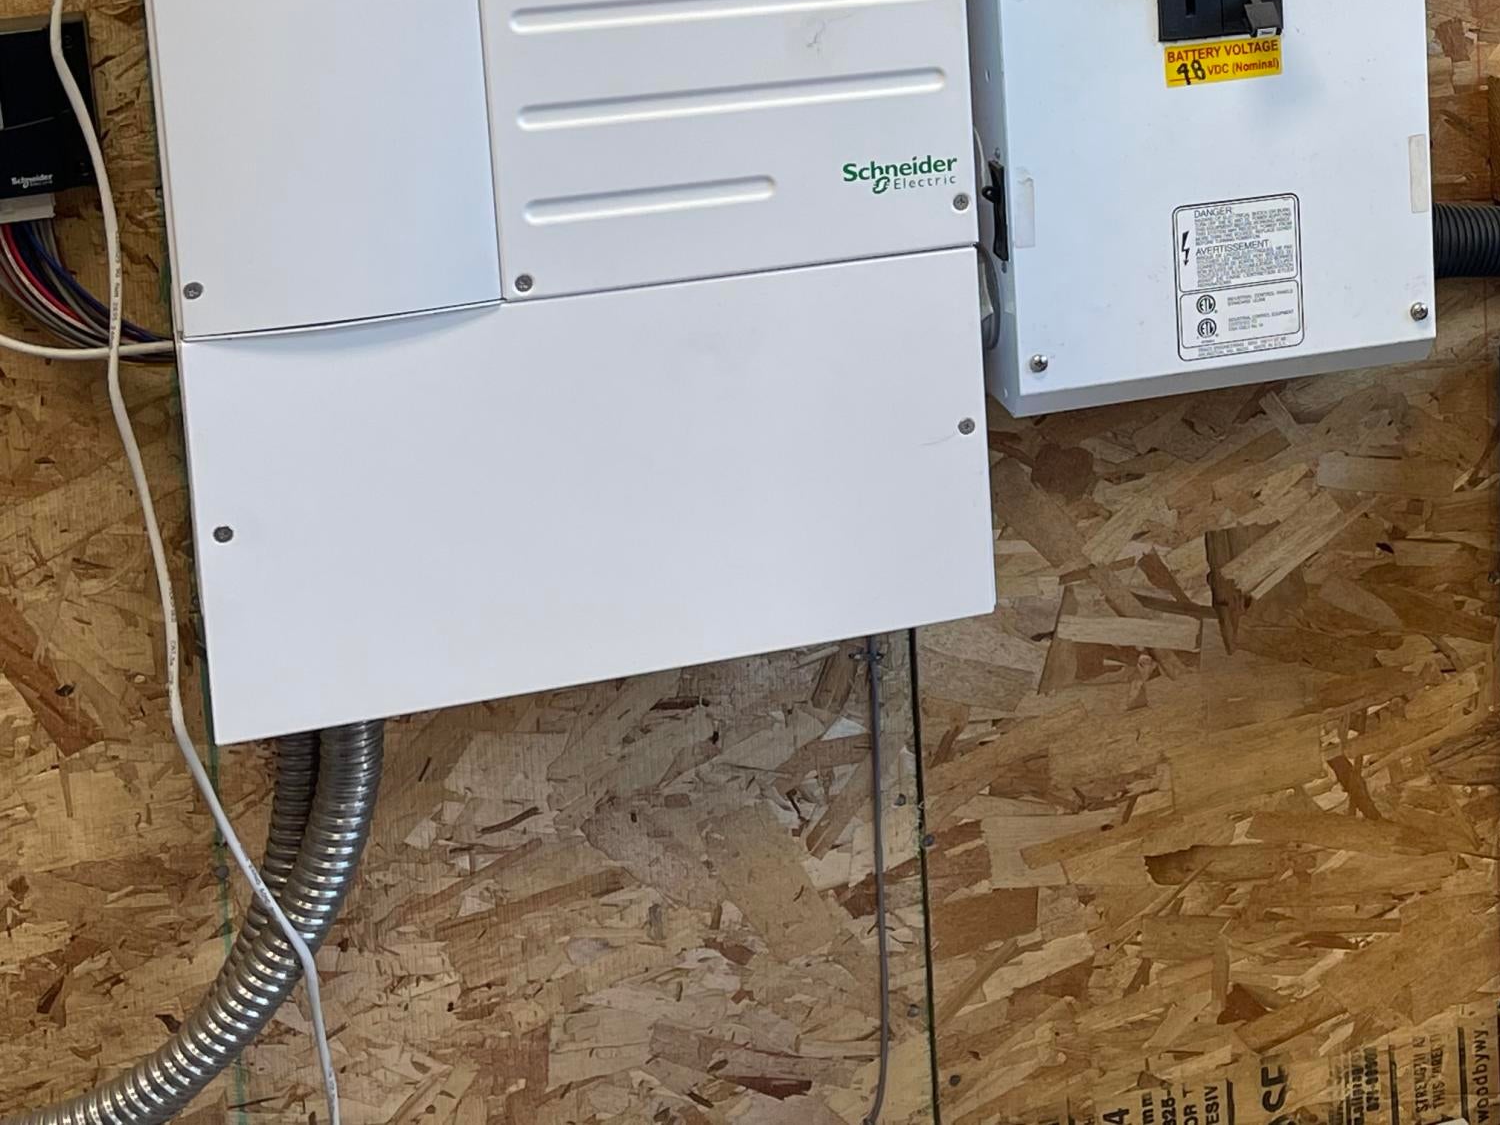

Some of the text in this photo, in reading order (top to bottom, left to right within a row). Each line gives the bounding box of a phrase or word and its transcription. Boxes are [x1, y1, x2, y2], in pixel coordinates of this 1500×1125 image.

[1167, 39, 1278, 63] BATTERY VOLTAGE
[1207, 57, 1280, 75] VDC (Nominal)
[843, 155, 957, 183] Schneider
[893, 175, 957, 190] Electric
[1194, 207, 1232, 218] DANGER
[1195, 239, 1269, 256] AVERTISSEMENT
